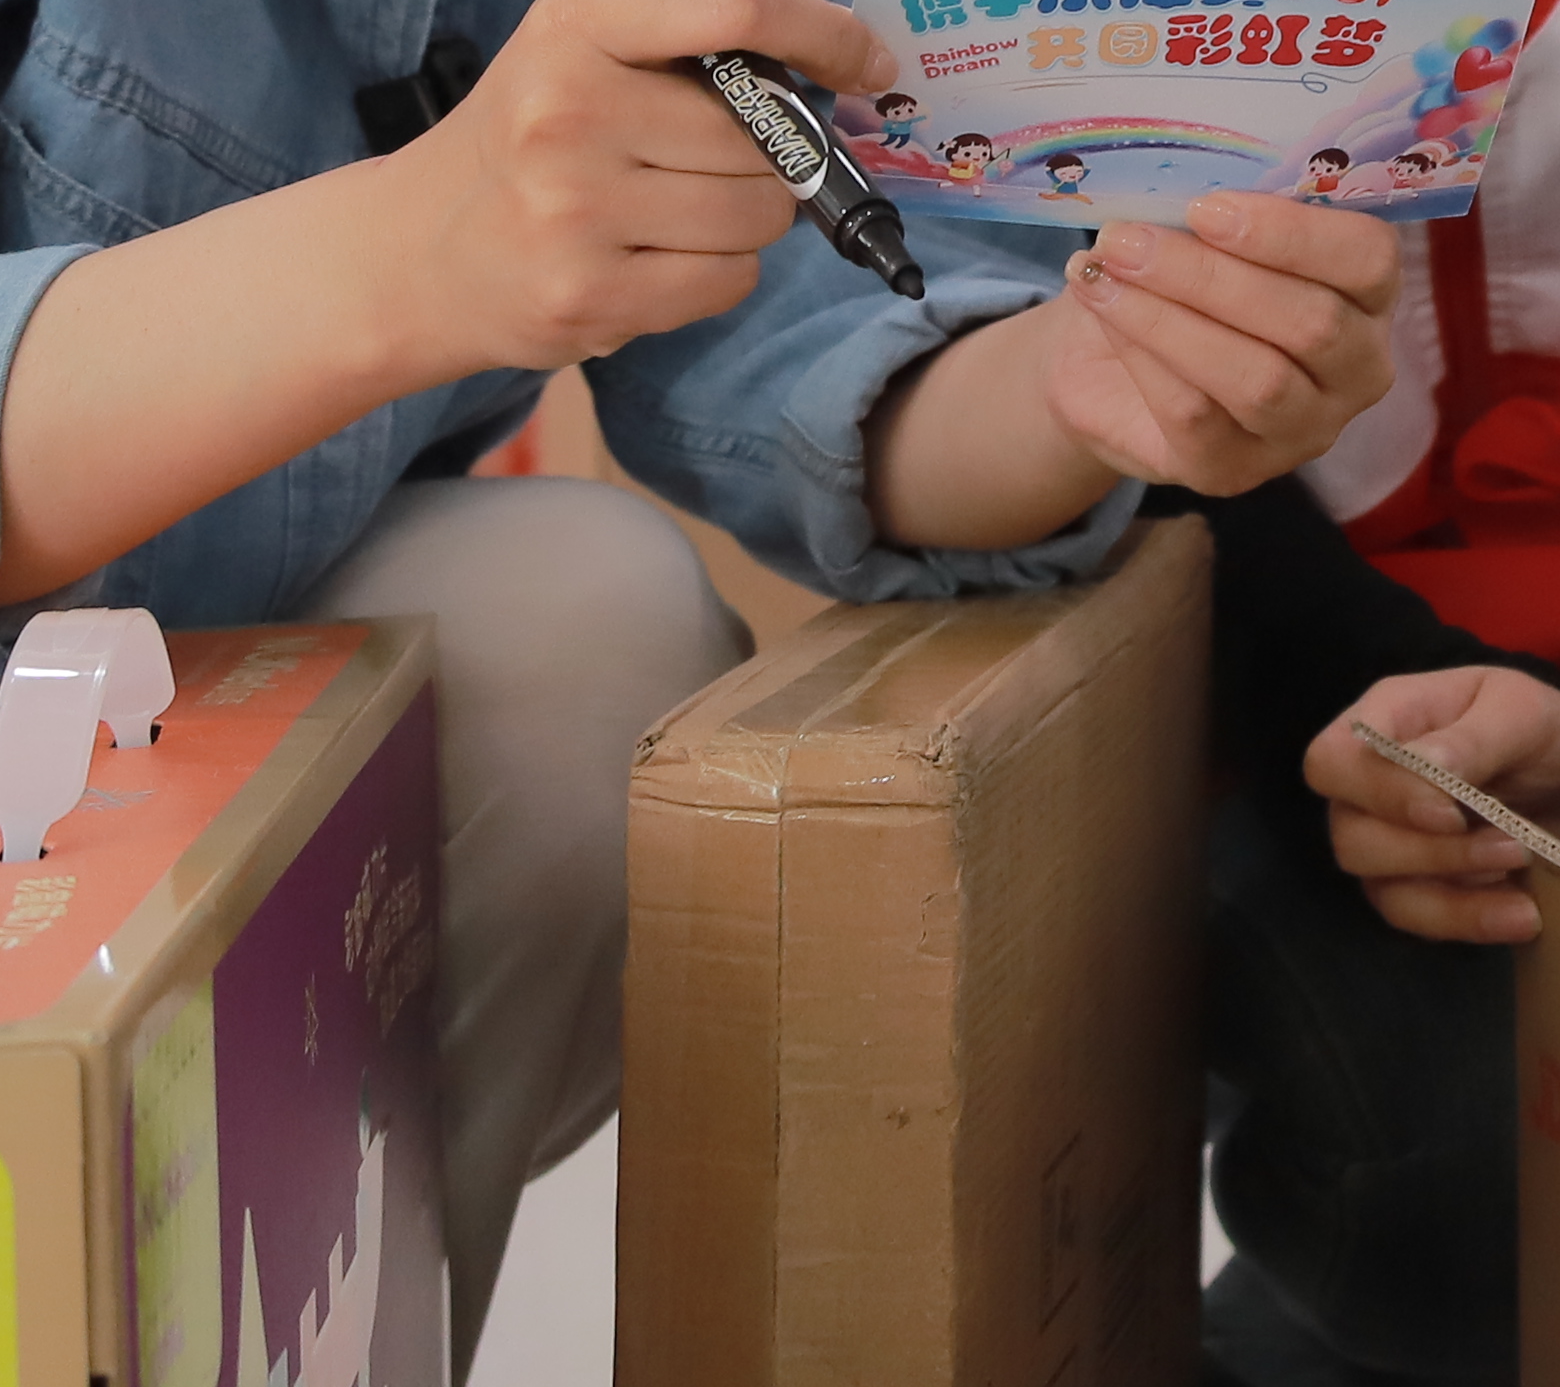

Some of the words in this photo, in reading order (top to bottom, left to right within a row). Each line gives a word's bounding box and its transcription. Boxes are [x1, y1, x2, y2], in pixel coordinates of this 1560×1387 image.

[919, 34, 1019, 65] Rainbow
[1027, 13, 1387, 69] 共圆彩虹梦
[924, 56, 1000, 79] Dream
[712, 56, 822, 178] MARKER
